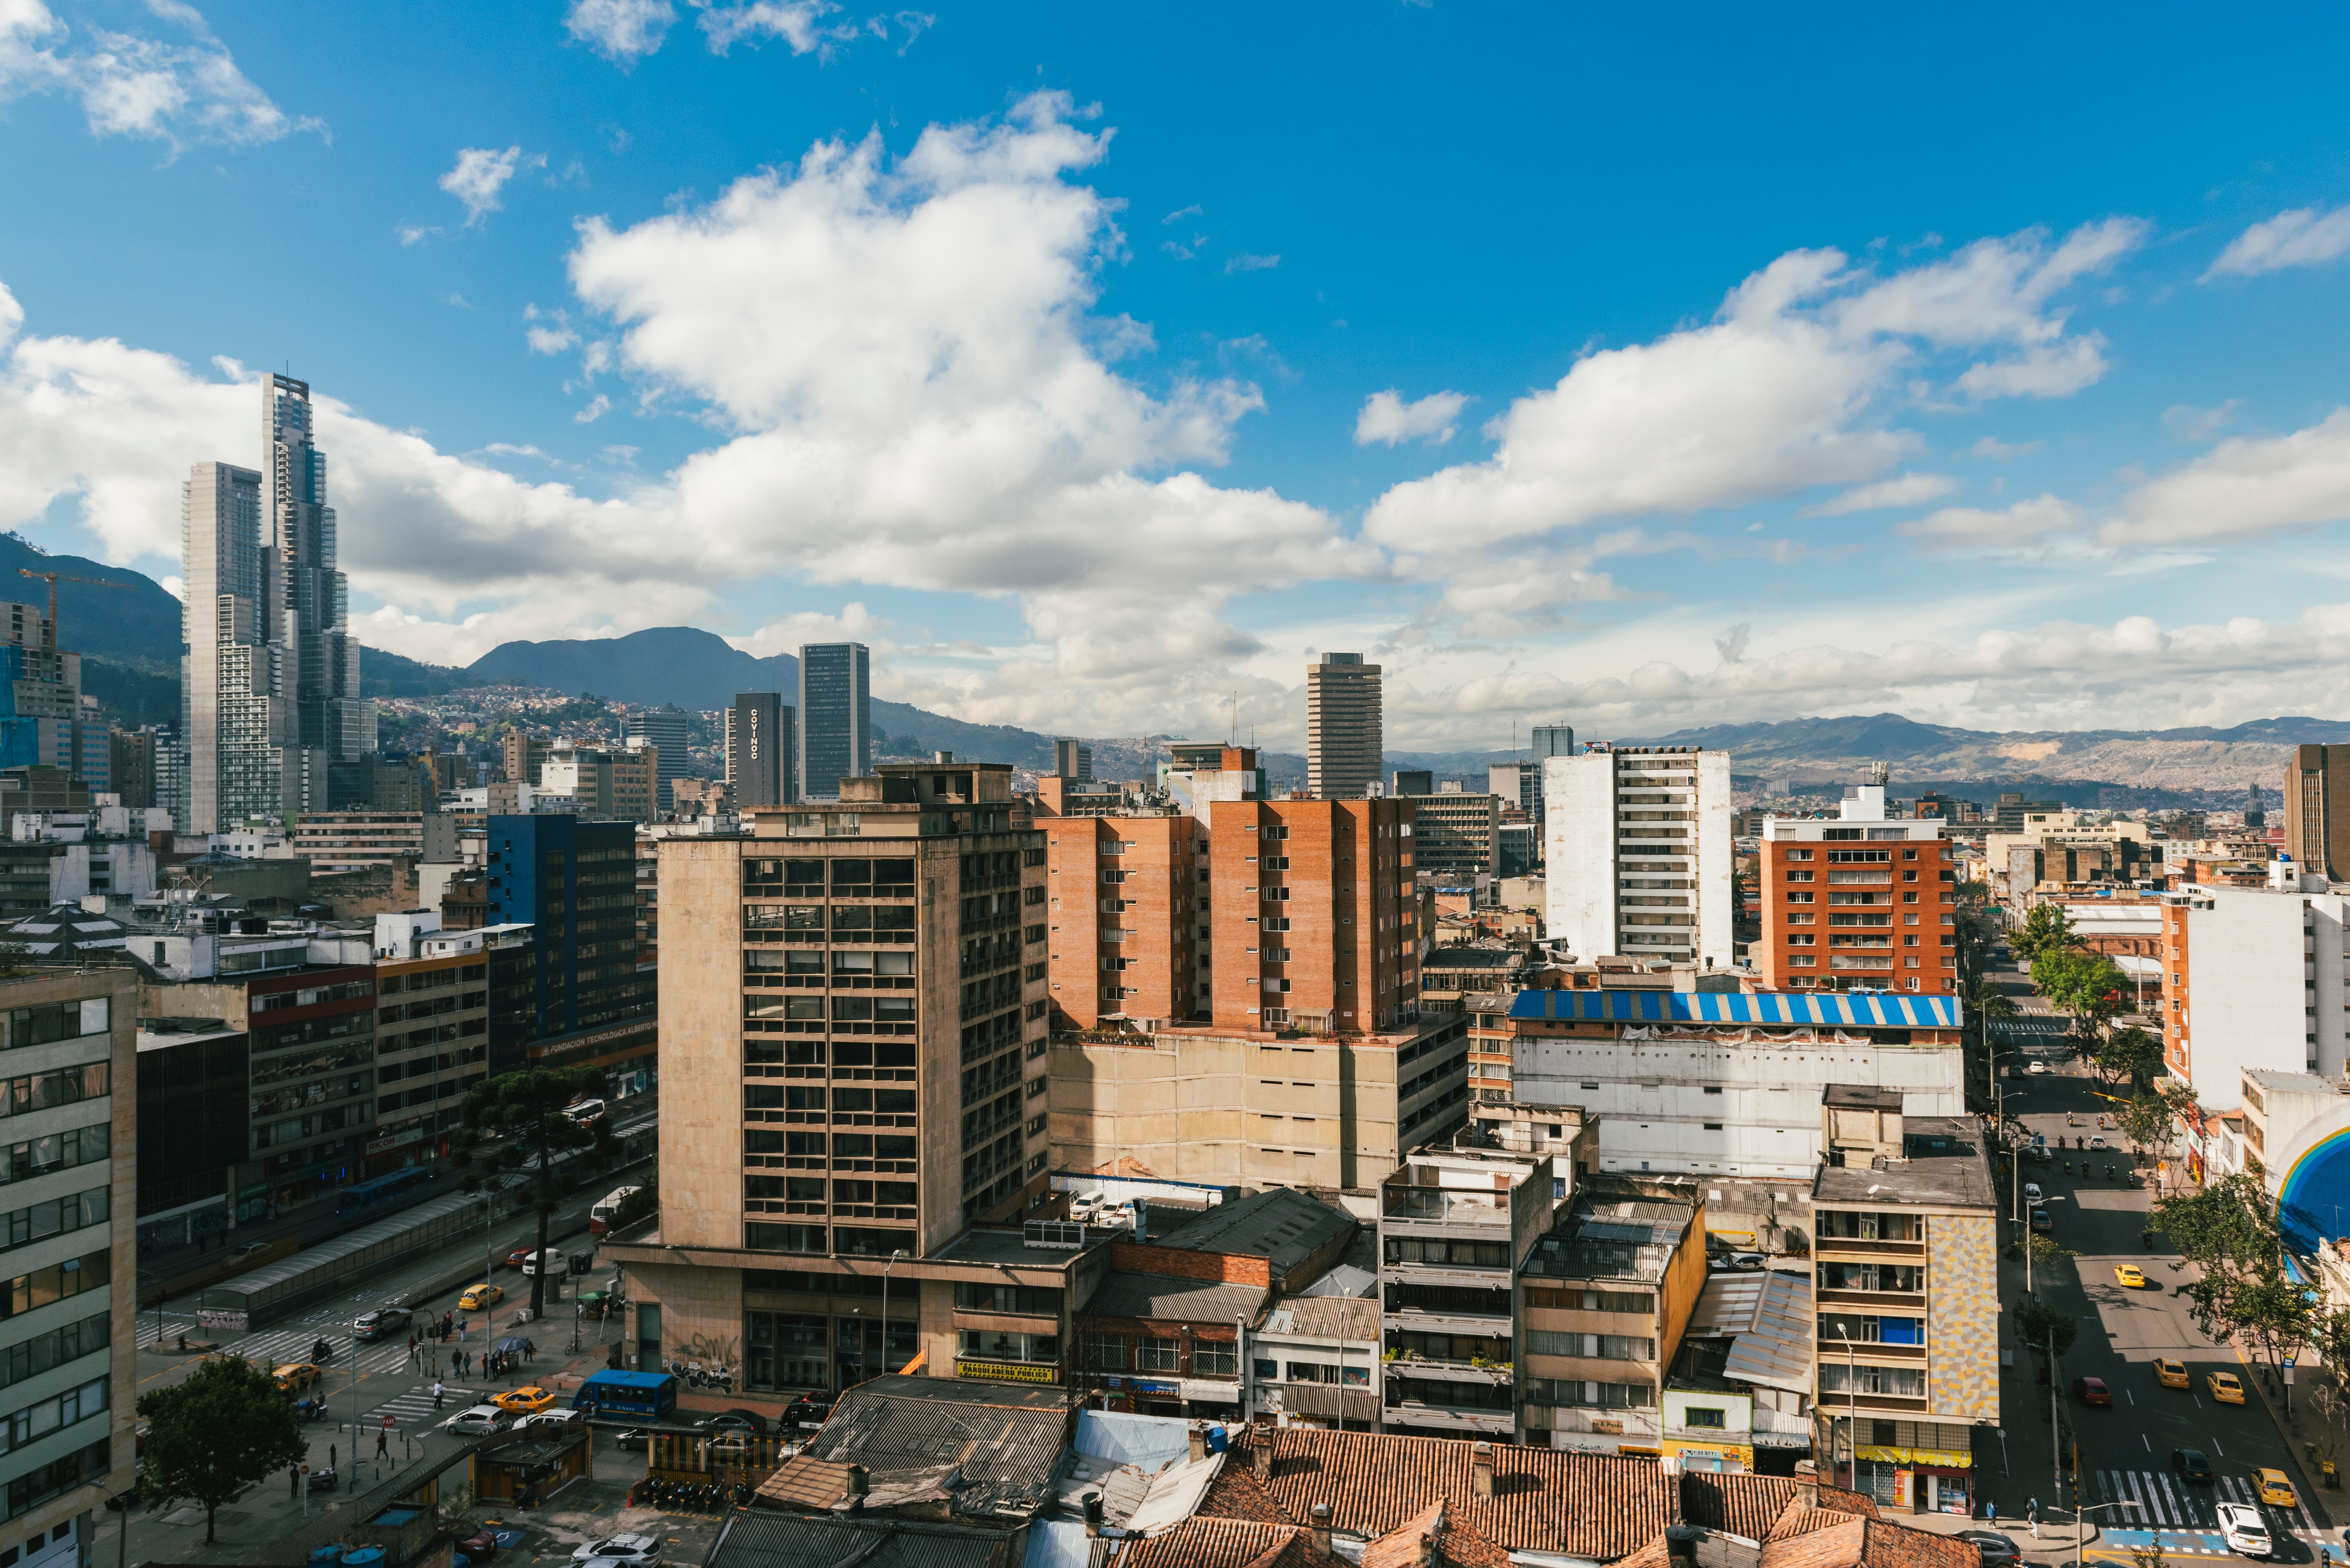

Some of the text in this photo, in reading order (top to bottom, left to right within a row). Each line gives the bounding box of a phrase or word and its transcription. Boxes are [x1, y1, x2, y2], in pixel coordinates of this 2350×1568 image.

[550, 1038, 585, 1053] FUNDACIÓN
[627, 1022, 651, 1034] ALBERTO
[369, 1137, 395, 1151] RICOH
[962, 1366, 1015, 1376] PARQUEADERO
[1870, 1445, 1892, 1454] Villa
